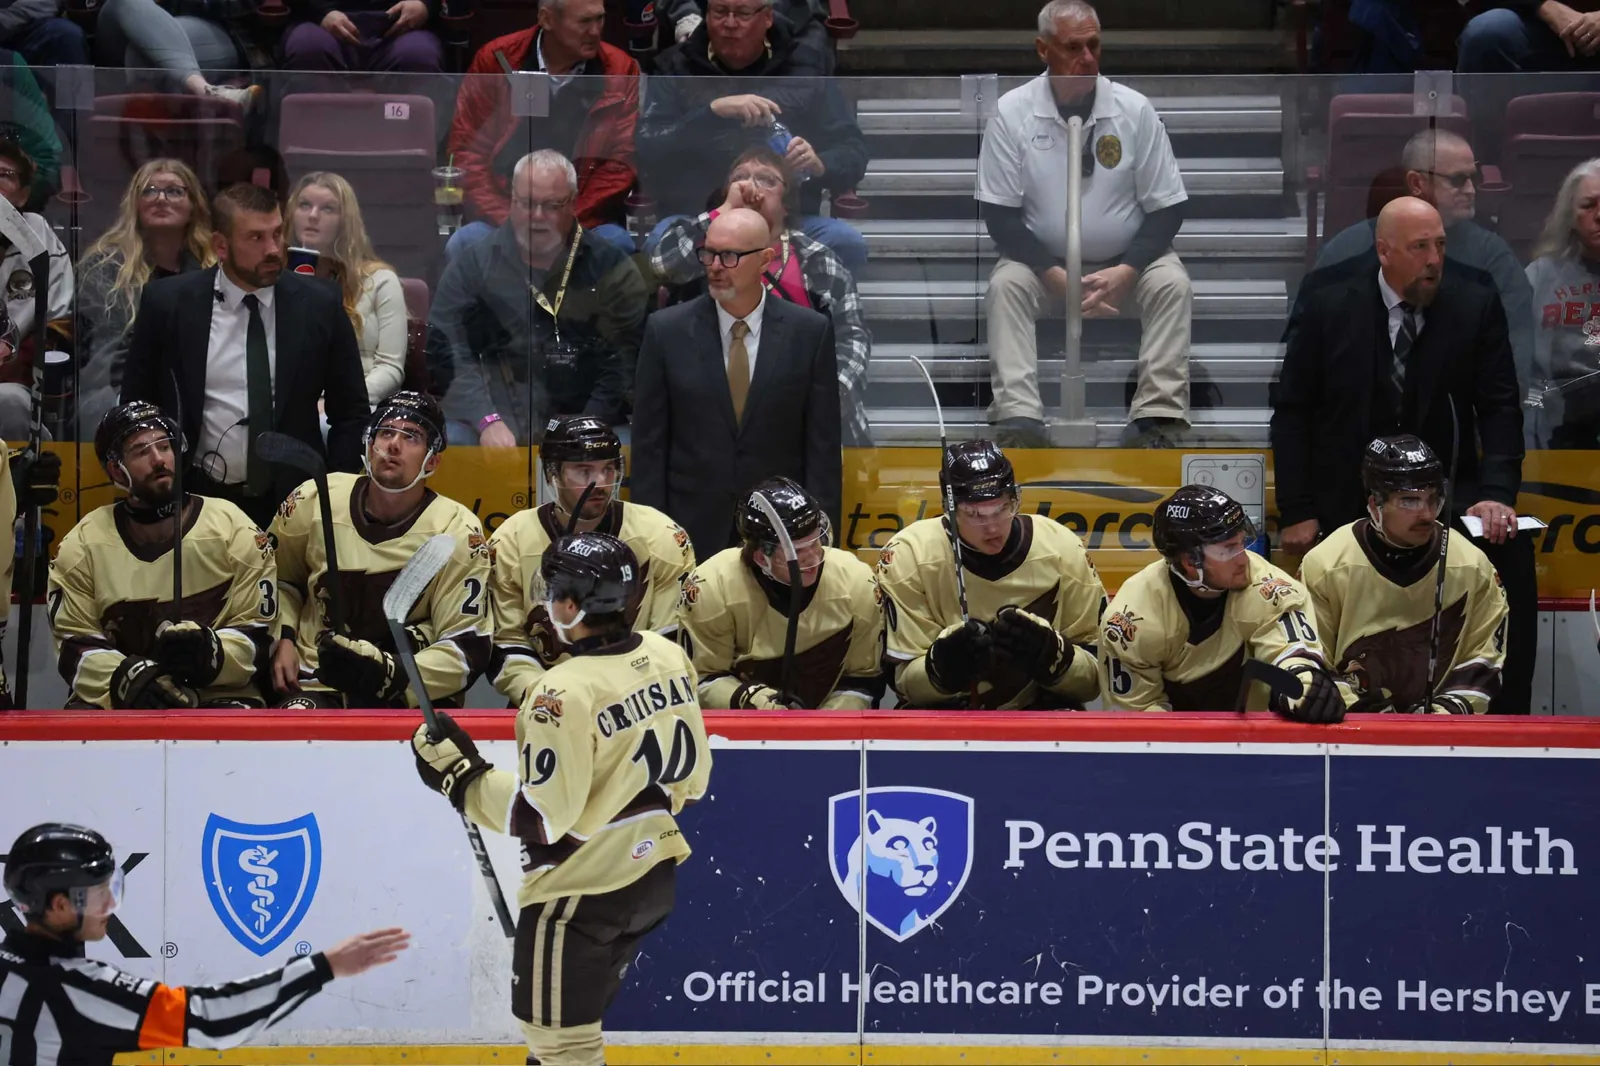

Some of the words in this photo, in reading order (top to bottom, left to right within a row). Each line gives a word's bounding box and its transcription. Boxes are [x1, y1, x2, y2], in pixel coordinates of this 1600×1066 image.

[391, 105, 404, 118] 16
[1166, 504, 1190, 519] PSECU
[620, 564, 634, 583] 19
[1278, 609, 1318, 644] 15
[630, 655, 649, 667] CCM
[521, 743, 557, 785] 19
[1004, 820, 1340, 872] PennState
[1356, 824, 1579, 876] Health
[683, 971, 826, 1004] Official
[842, 972, 1063, 1006] Healthcare
[1078, 974, 1250, 1008] Provider
[1263, 977, 1304, 1010] of
[1317, 978, 1383, 1011] the
[1398, 980, 1571, 1022] Hershey
